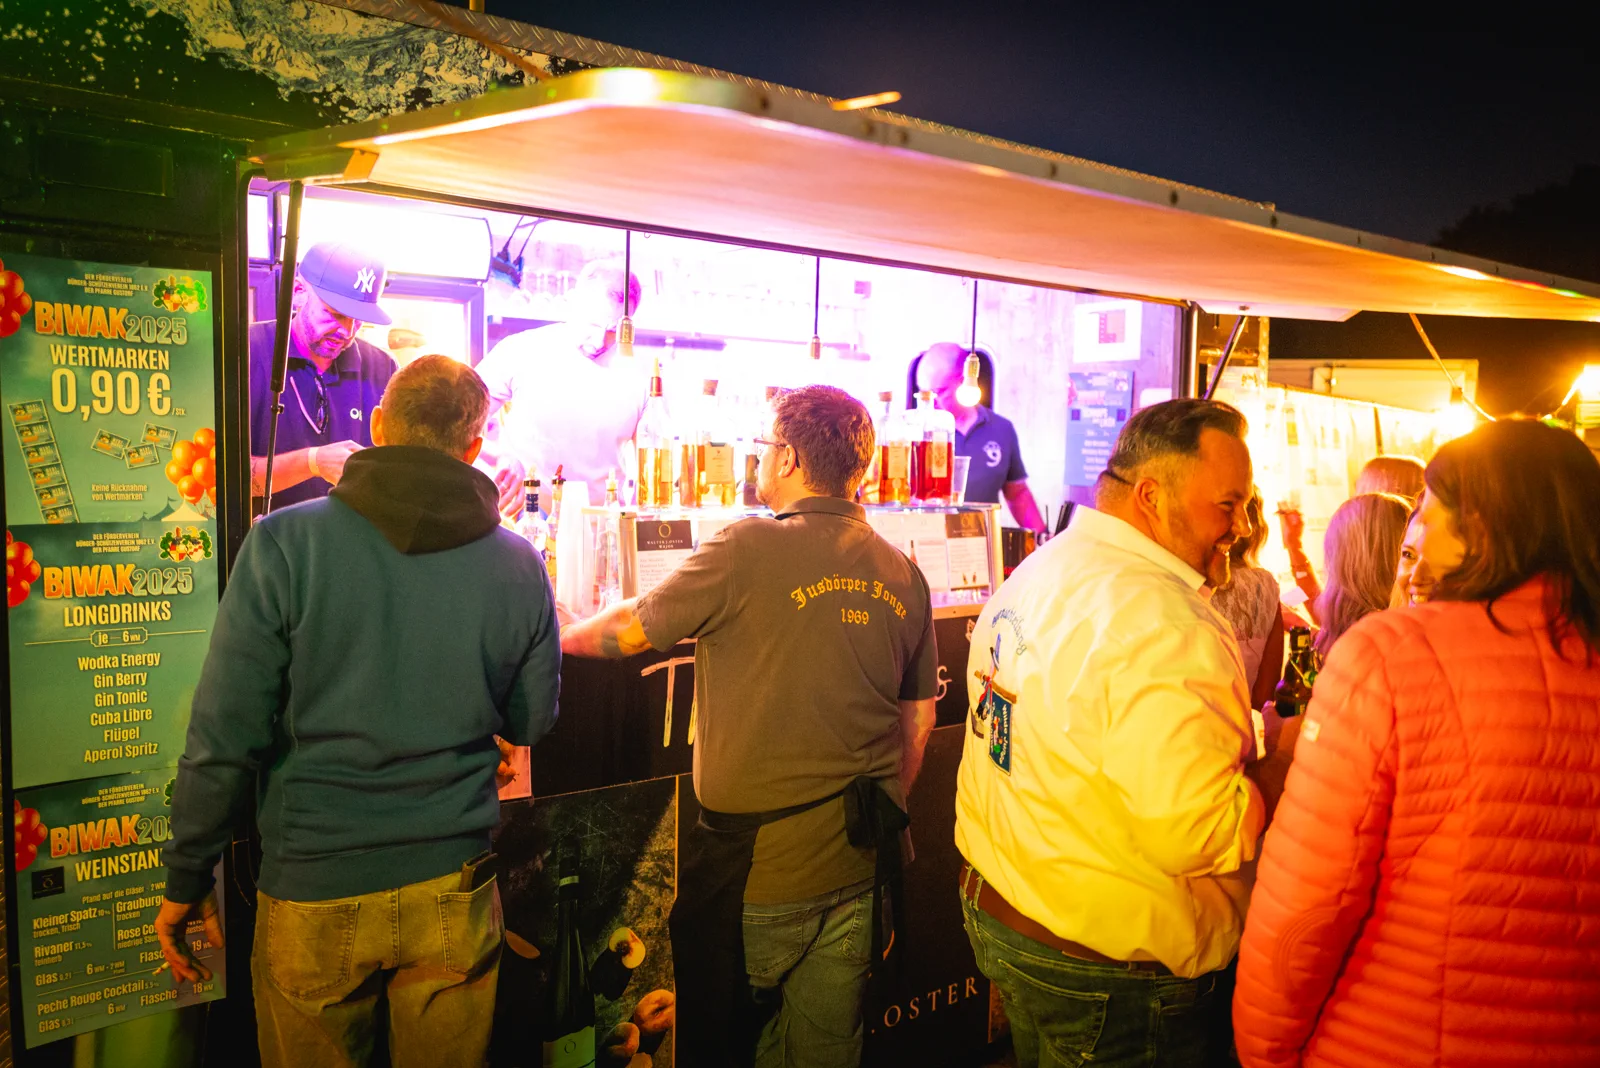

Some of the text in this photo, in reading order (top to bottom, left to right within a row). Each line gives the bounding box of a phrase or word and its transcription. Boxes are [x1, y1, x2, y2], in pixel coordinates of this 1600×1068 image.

[50, 344, 170, 370] WERTMARKEN
[52, 368, 140, 422] 0,90
[147, 372, 171, 416] €
[64, 601, 172, 627] LONGDRINKS
[841, 608, 869, 625] 1969
[98, 632, 108, 644] je
[78, 653, 160, 670] Wodka Energy
[94, 672, 147, 688] Gin Berry
[95, 690, 147, 707] Gin Tonic
[90, 708, 152, 726] Cuba Libre
[104, 727, 140, 742] Flügel
[84, 743, 158, 763] Aperol Spritz
[75, 848, 164, 882] WEINSTAN
[82, 894, 101, 904] Pfand
[102, 892, 113, 900] auf
[114, 889, 124, 898] die
[33, 912, 69, 930] Kleiner
[70, 907, 97, 923] Spatz
[116, 911, 140, 921] trocken
[62, 922, 80, 933] frisch
[118, 924, 157, 941] Rose Co
[35, 941, 73, 958] Rivaner
[140, 950, 165, 963] Flasc
[192, 940, 201, 951] 19
[36, 972, 58, 986] Glas
[37, 1000, 68, 1016] Peche
[70, 991, 102, 1007] Rouge
[104, 980, 144, 999] Cocktail
[38, 1019, 60, 1033] Glas
[140, 989, 177, 1006] Flasche
[193, 982, 202, 994] 18
